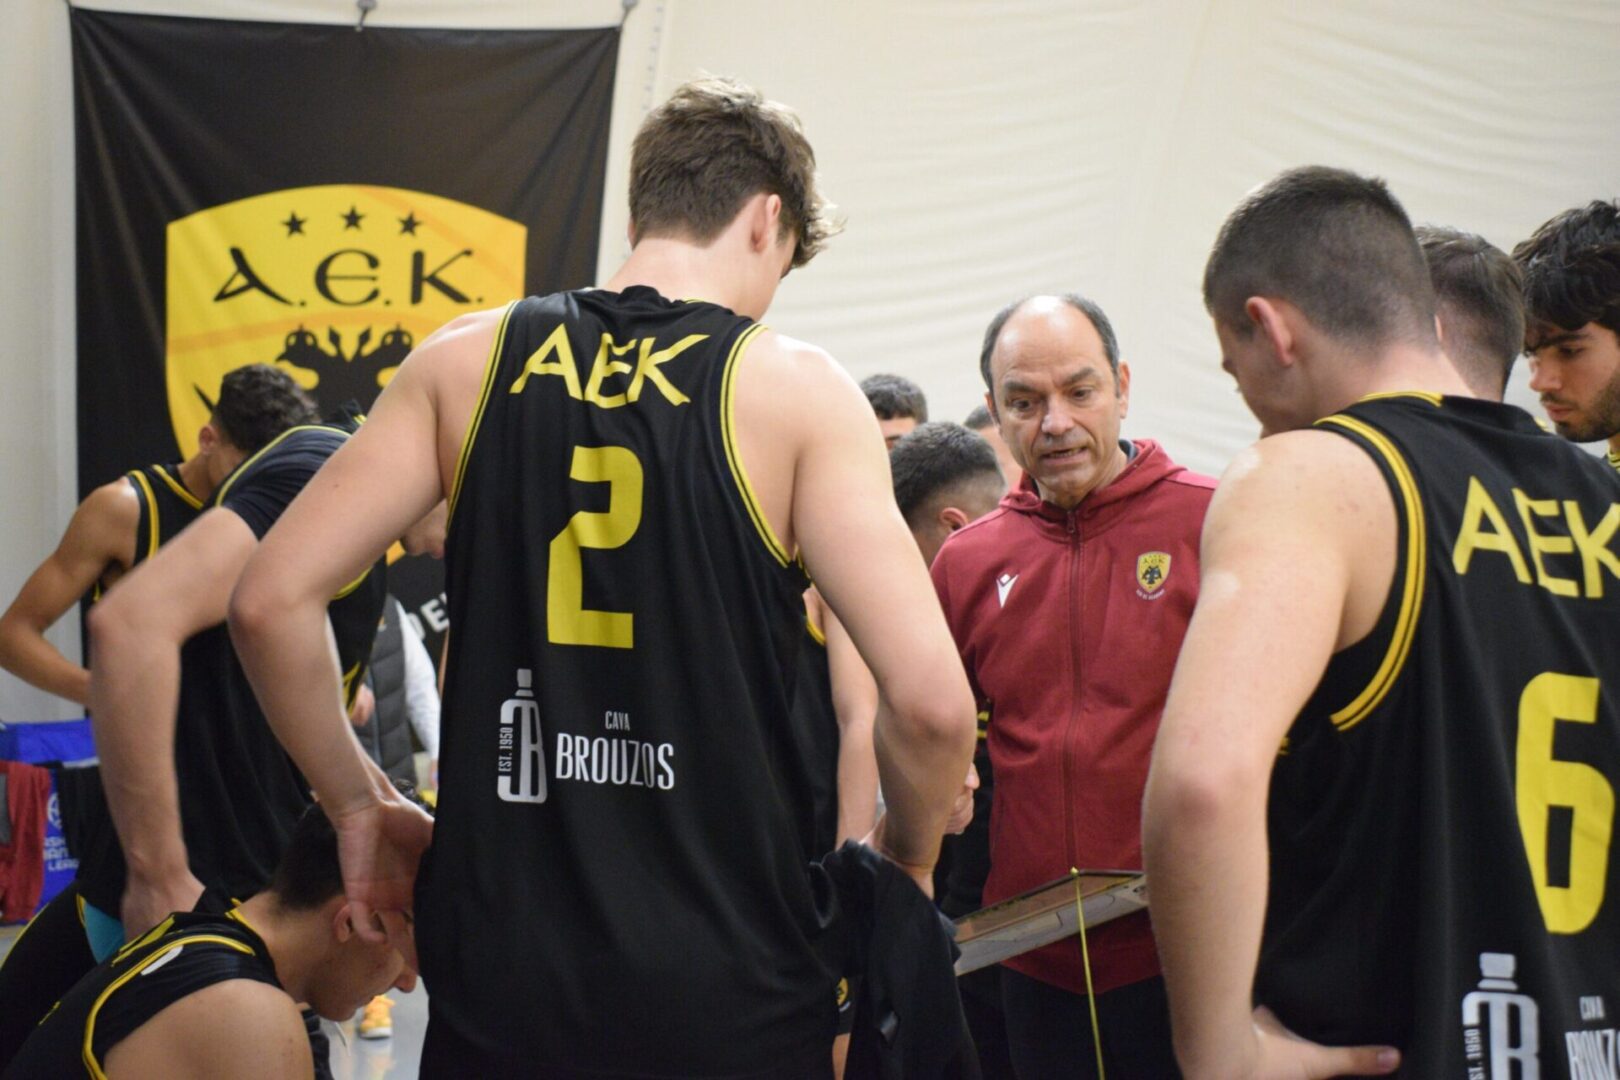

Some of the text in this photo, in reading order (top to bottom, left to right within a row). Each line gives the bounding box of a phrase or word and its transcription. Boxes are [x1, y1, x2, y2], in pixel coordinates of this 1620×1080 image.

[509, 323, 711, 409] AEK
[547, 445, 644, 649] 2
[1452, 475, 1620, 598] AEK
[498, 727, 513, 771] EST. 1950
[556, 732, 675, 790] BROUZOS
[605, 711, 631, 731] CAVA
[1516, 672, 1616, 935] 6
